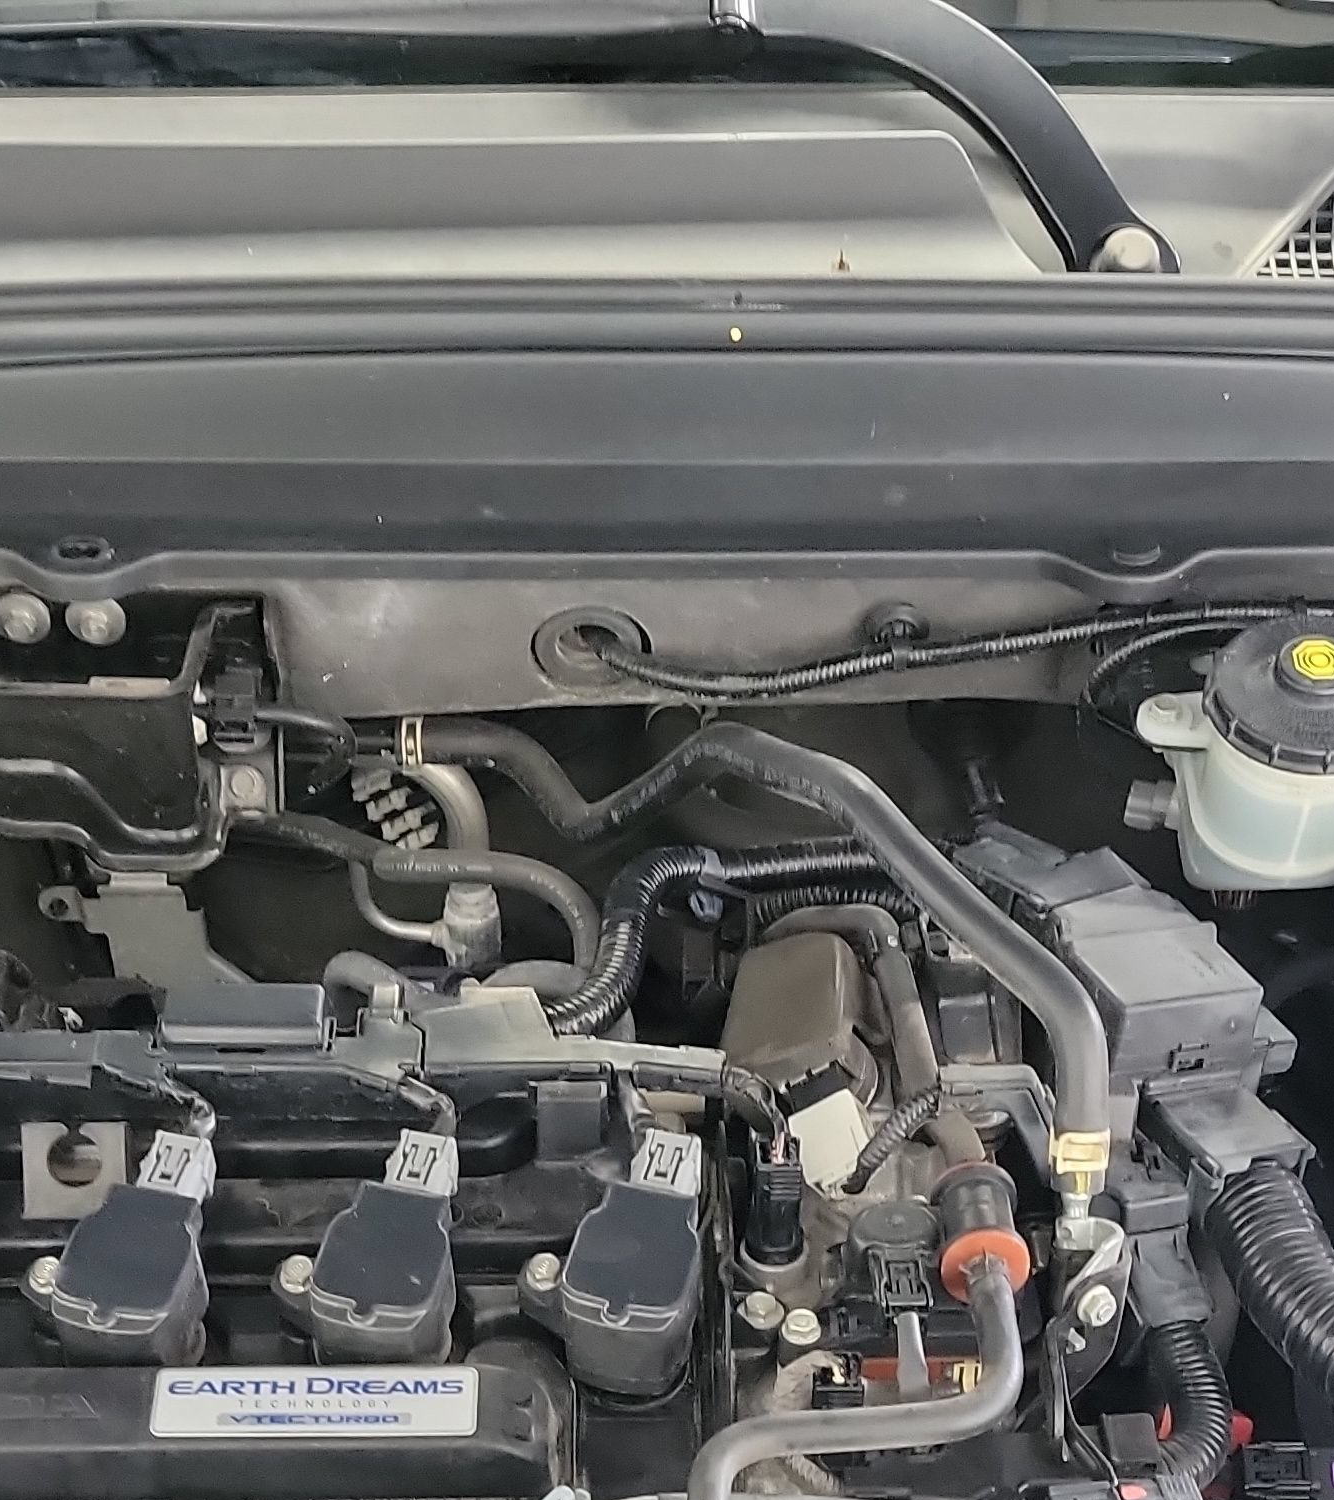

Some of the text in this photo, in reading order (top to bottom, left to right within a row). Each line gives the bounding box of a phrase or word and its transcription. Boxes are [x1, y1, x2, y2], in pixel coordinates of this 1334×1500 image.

[168, 1377, 464, 1395] EARTH DREAMS
[238, 1400, 391, 1409] TECHNOLOGY
